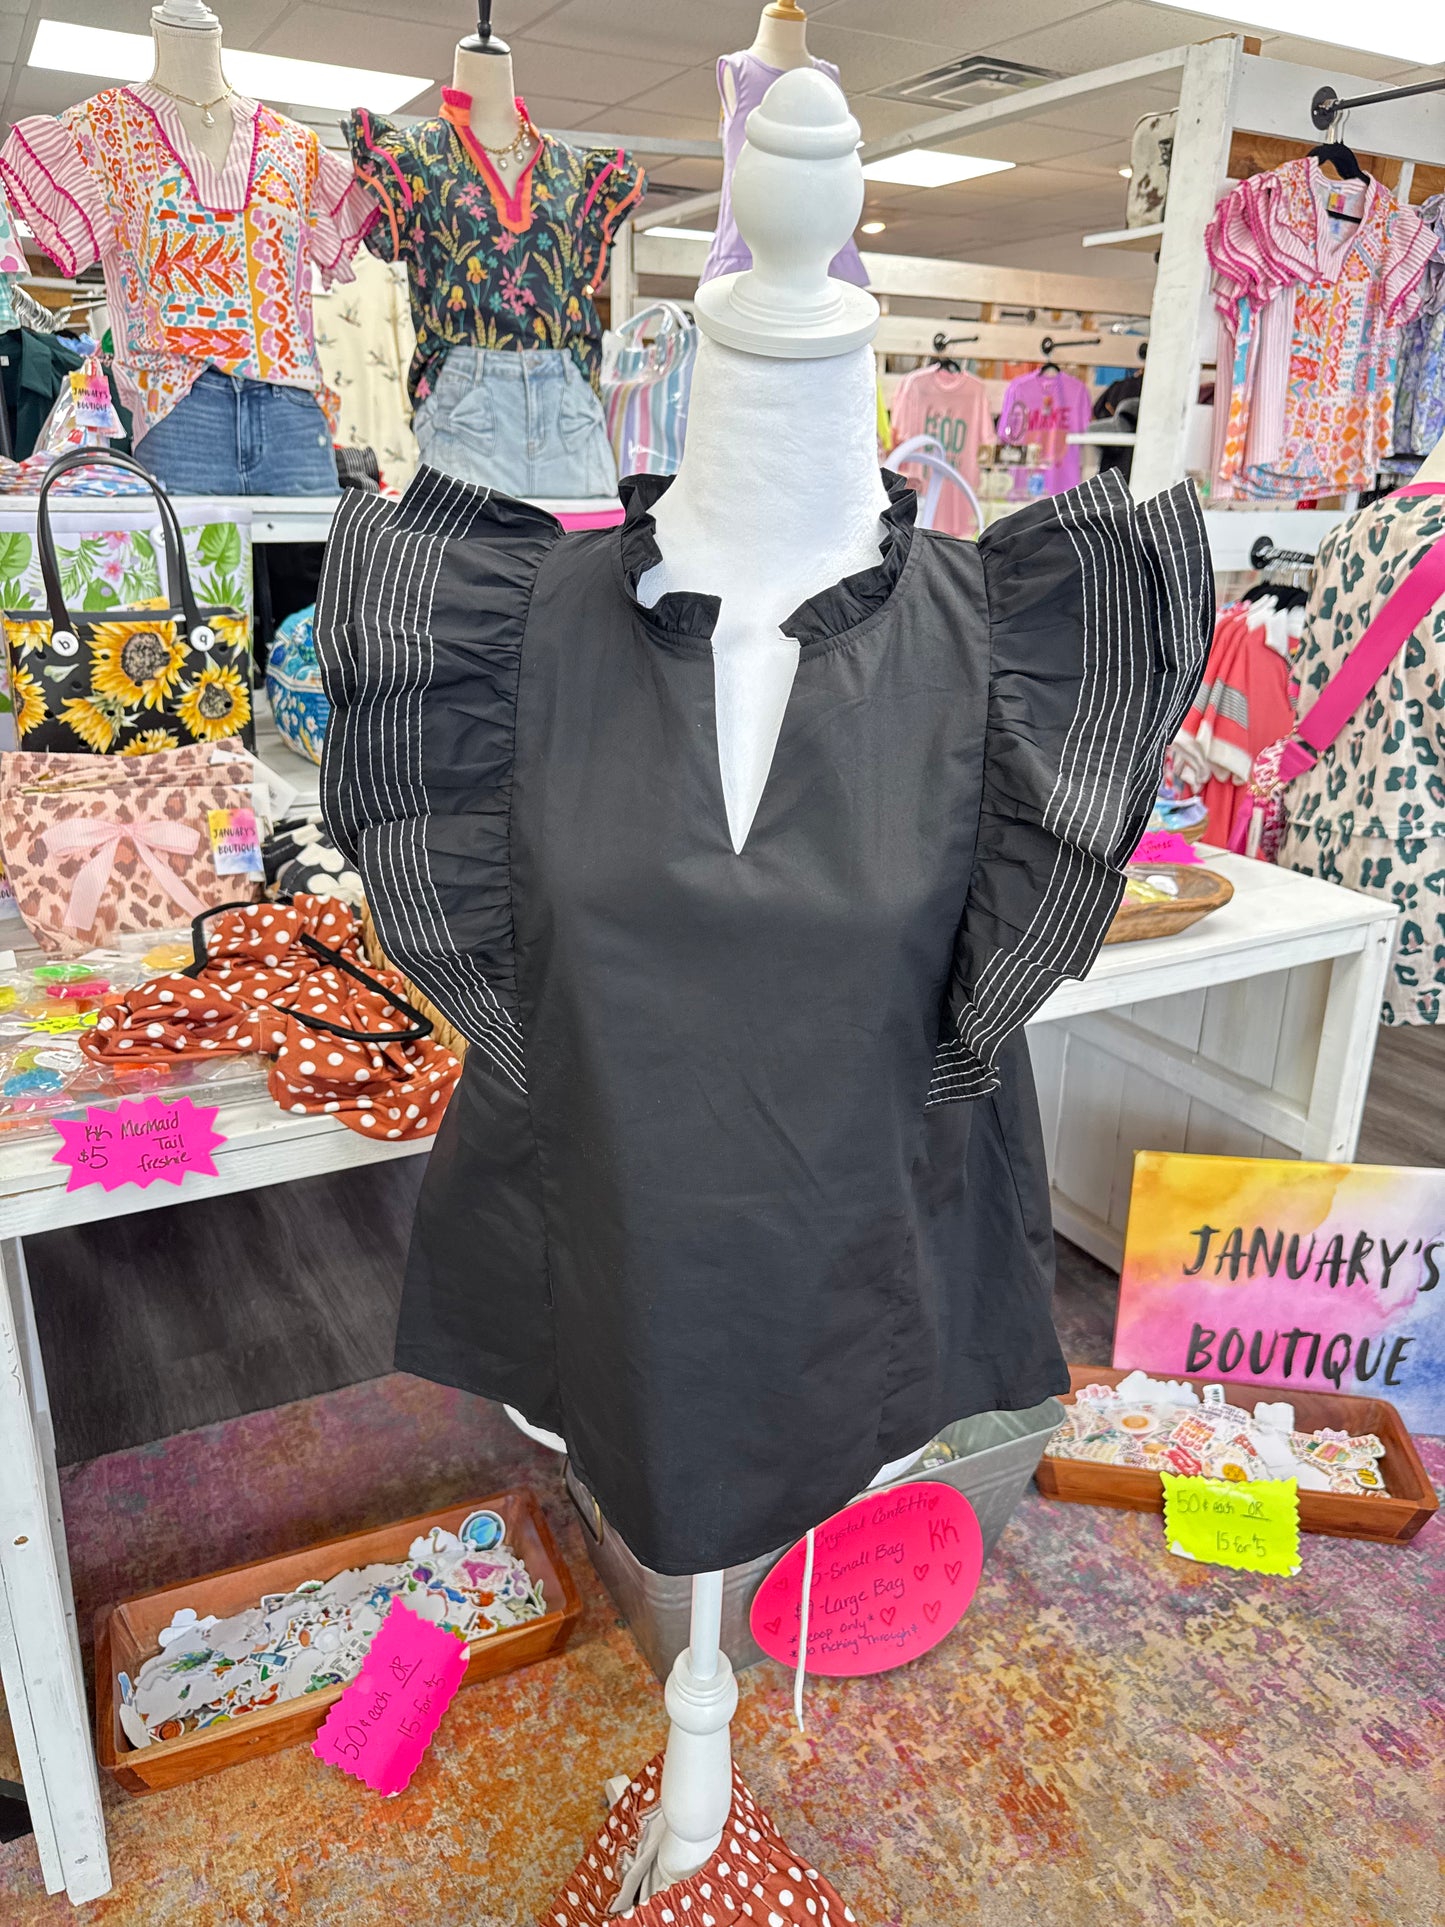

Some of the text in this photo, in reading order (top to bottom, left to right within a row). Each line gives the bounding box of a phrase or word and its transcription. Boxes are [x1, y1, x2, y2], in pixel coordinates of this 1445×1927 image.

[213, 826, 256, 839] JANUARY'S
[217, 843, 255, 855] BOUTIQUE
[152, 1134, 185, 1151] Tail
[77, 1146, 109, 1169] $5
[1183, 1224, 1445, 1292] JANUARY'S
[1184, 1323, 1416, 1391] BOUTIQUE
[1216, 1530, 1230, 1551] 15
[875, 1541, 905, 1564] Bag
[873, 1576, 905, 1599] Bag
[368, 1689, 392, 1721] each
[397, 1673, 446, 1740] 15 for $5
